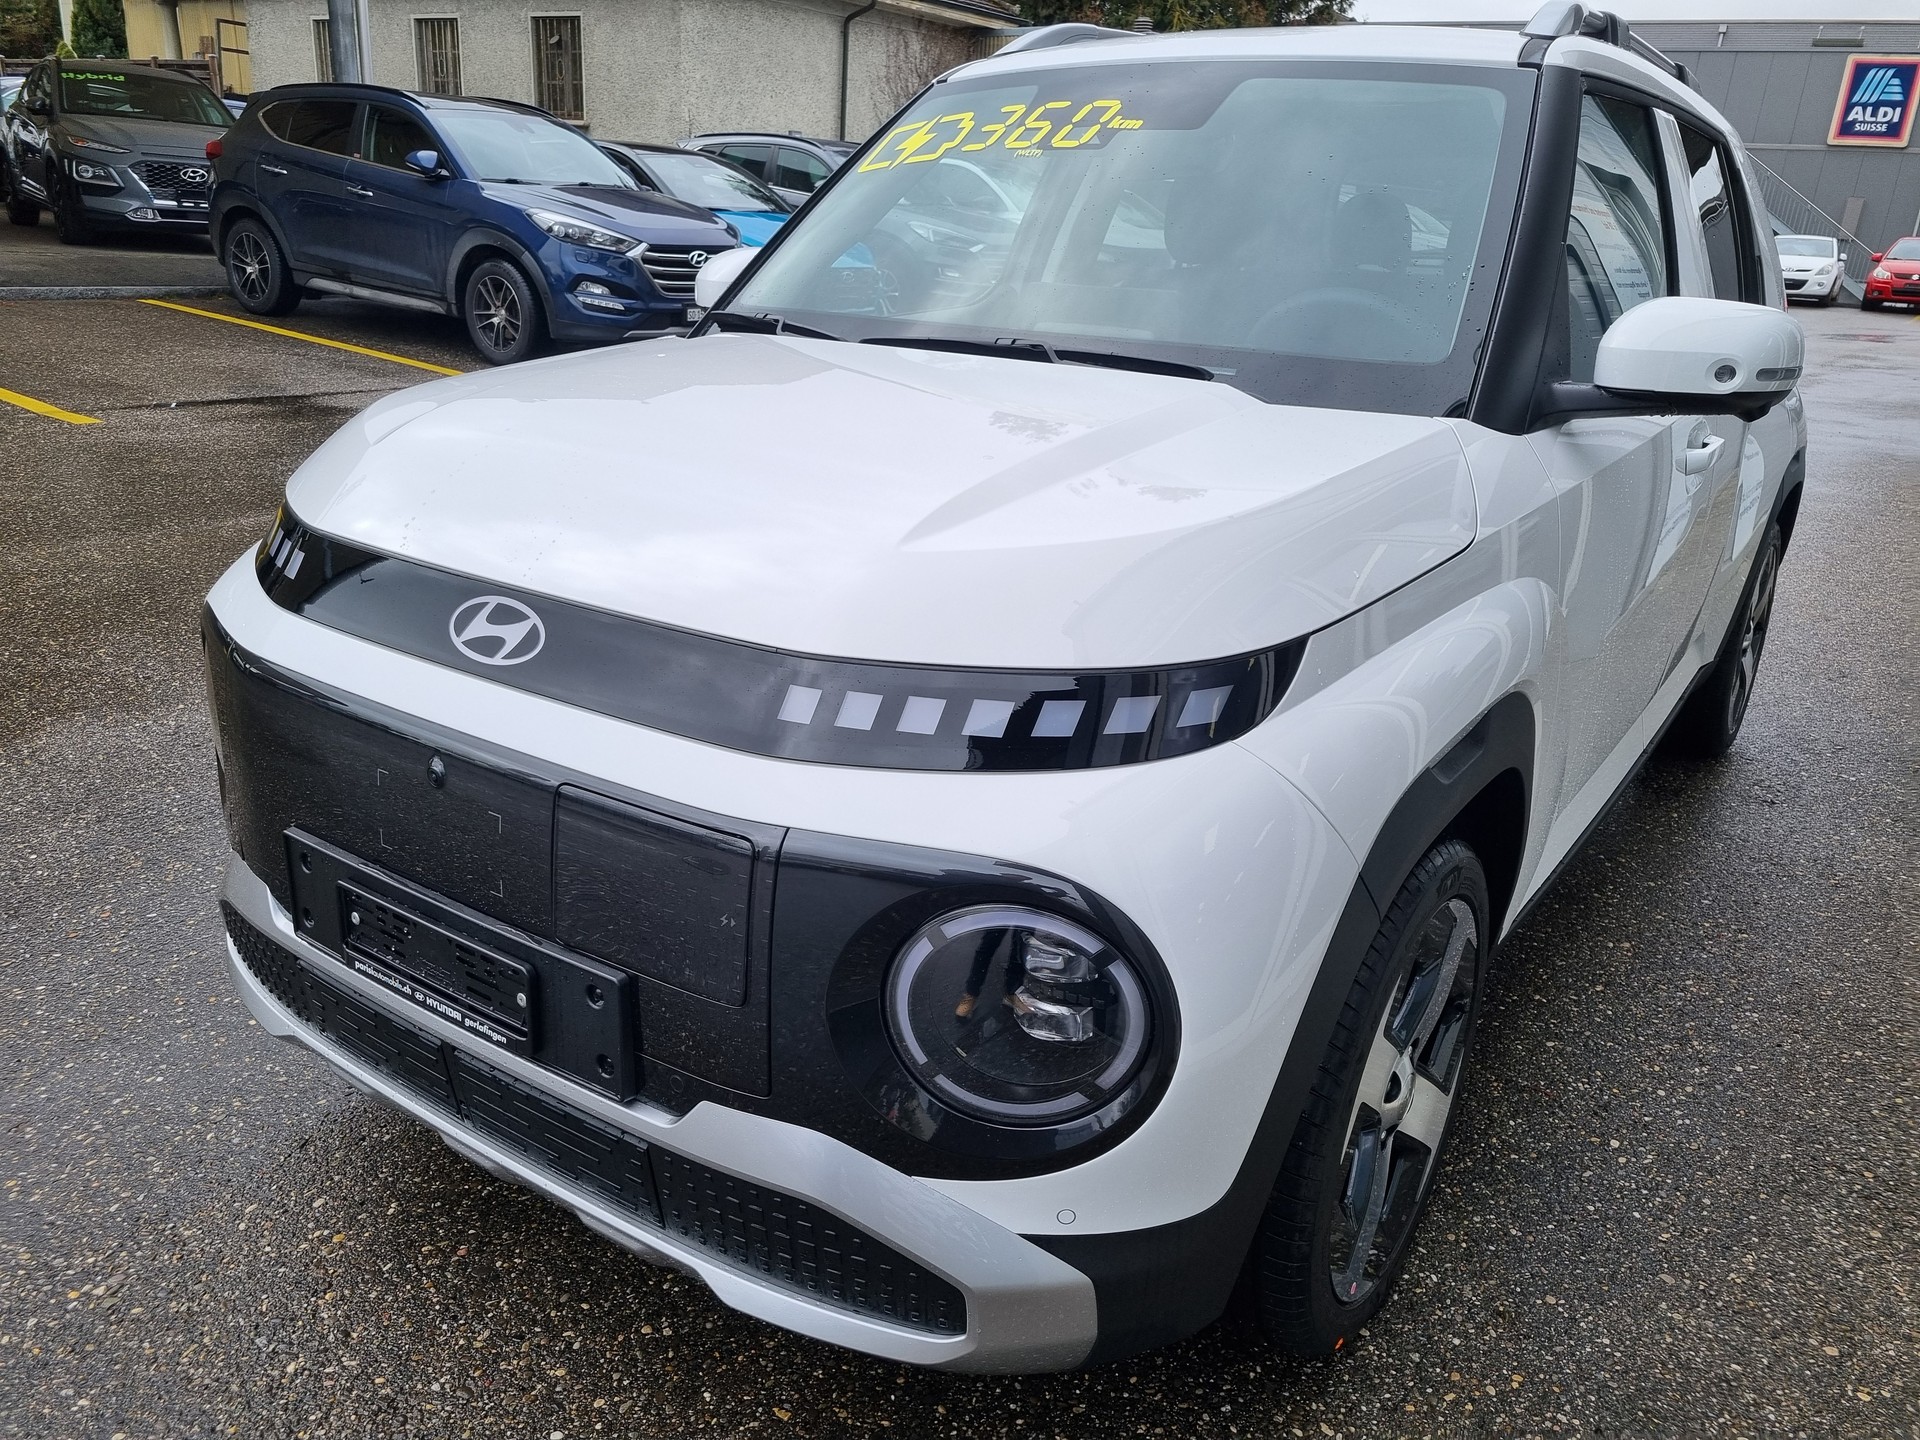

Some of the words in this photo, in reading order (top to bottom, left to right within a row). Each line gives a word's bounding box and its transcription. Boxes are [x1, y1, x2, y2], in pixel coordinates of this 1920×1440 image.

[61, 72, 125, 82] Hybrid
[1847, 106, 1902, 122] ALDI
[961, 100, 1122, 152] 360
[1106, 116, 1144, 130] km
[1854, 123, 1888, 132] SUISSE
[426, 997, 462, 1022] HYUNDAI
[464, 1017, 507, 1044] gerlafingen
